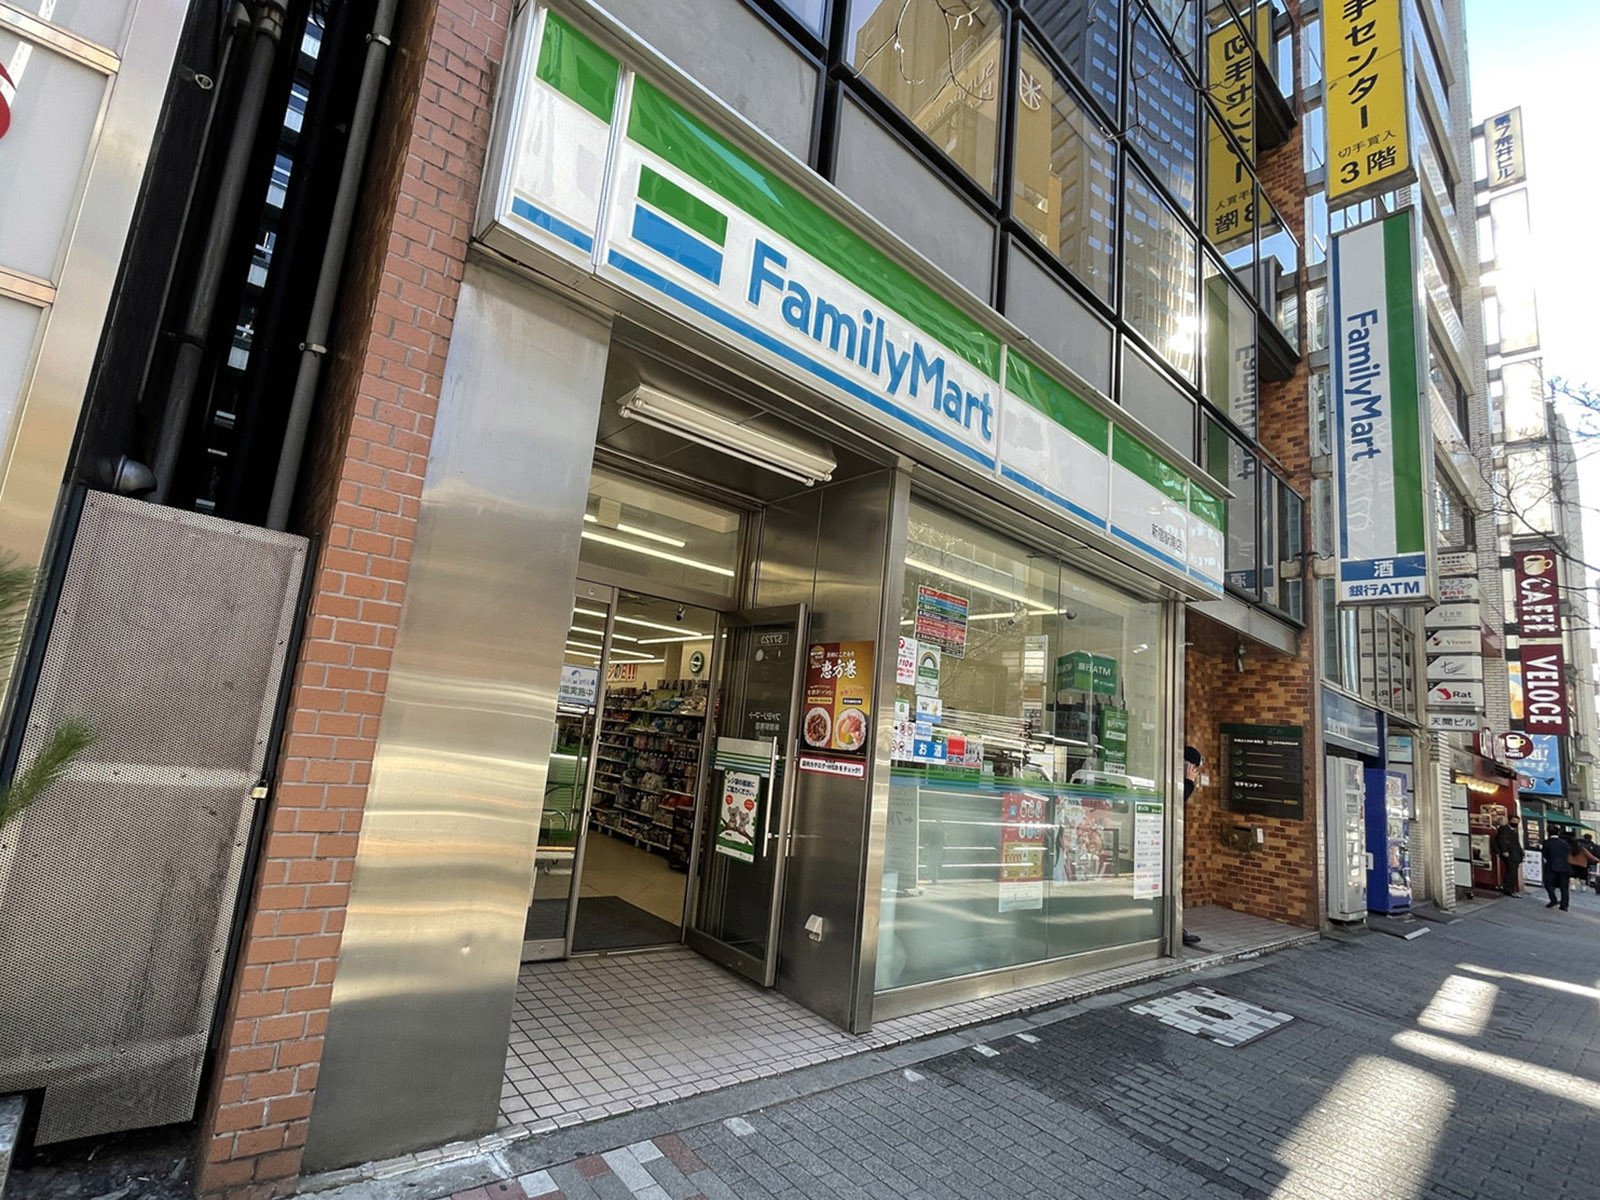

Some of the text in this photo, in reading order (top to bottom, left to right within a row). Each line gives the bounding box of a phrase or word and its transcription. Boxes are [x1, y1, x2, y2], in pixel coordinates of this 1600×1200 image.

[1338, 130, 1396, 158] 切手買入
[1340, 145, 1396, 184] 3階
[747, 238, 994, 441] FamilyMart
[1345, 309, 1382, 461] FamilyMart
[1374, 560, 1394, 577] 酒
[1349, 581, 1420, 597] 銀行ATM
[821, 659, 856, 679] 恵方巻
[559, 685, 594, 697] 電実施中
[1526, 655, 1562, 725] VELOCE
[918, 742, 942, 758] お酒
